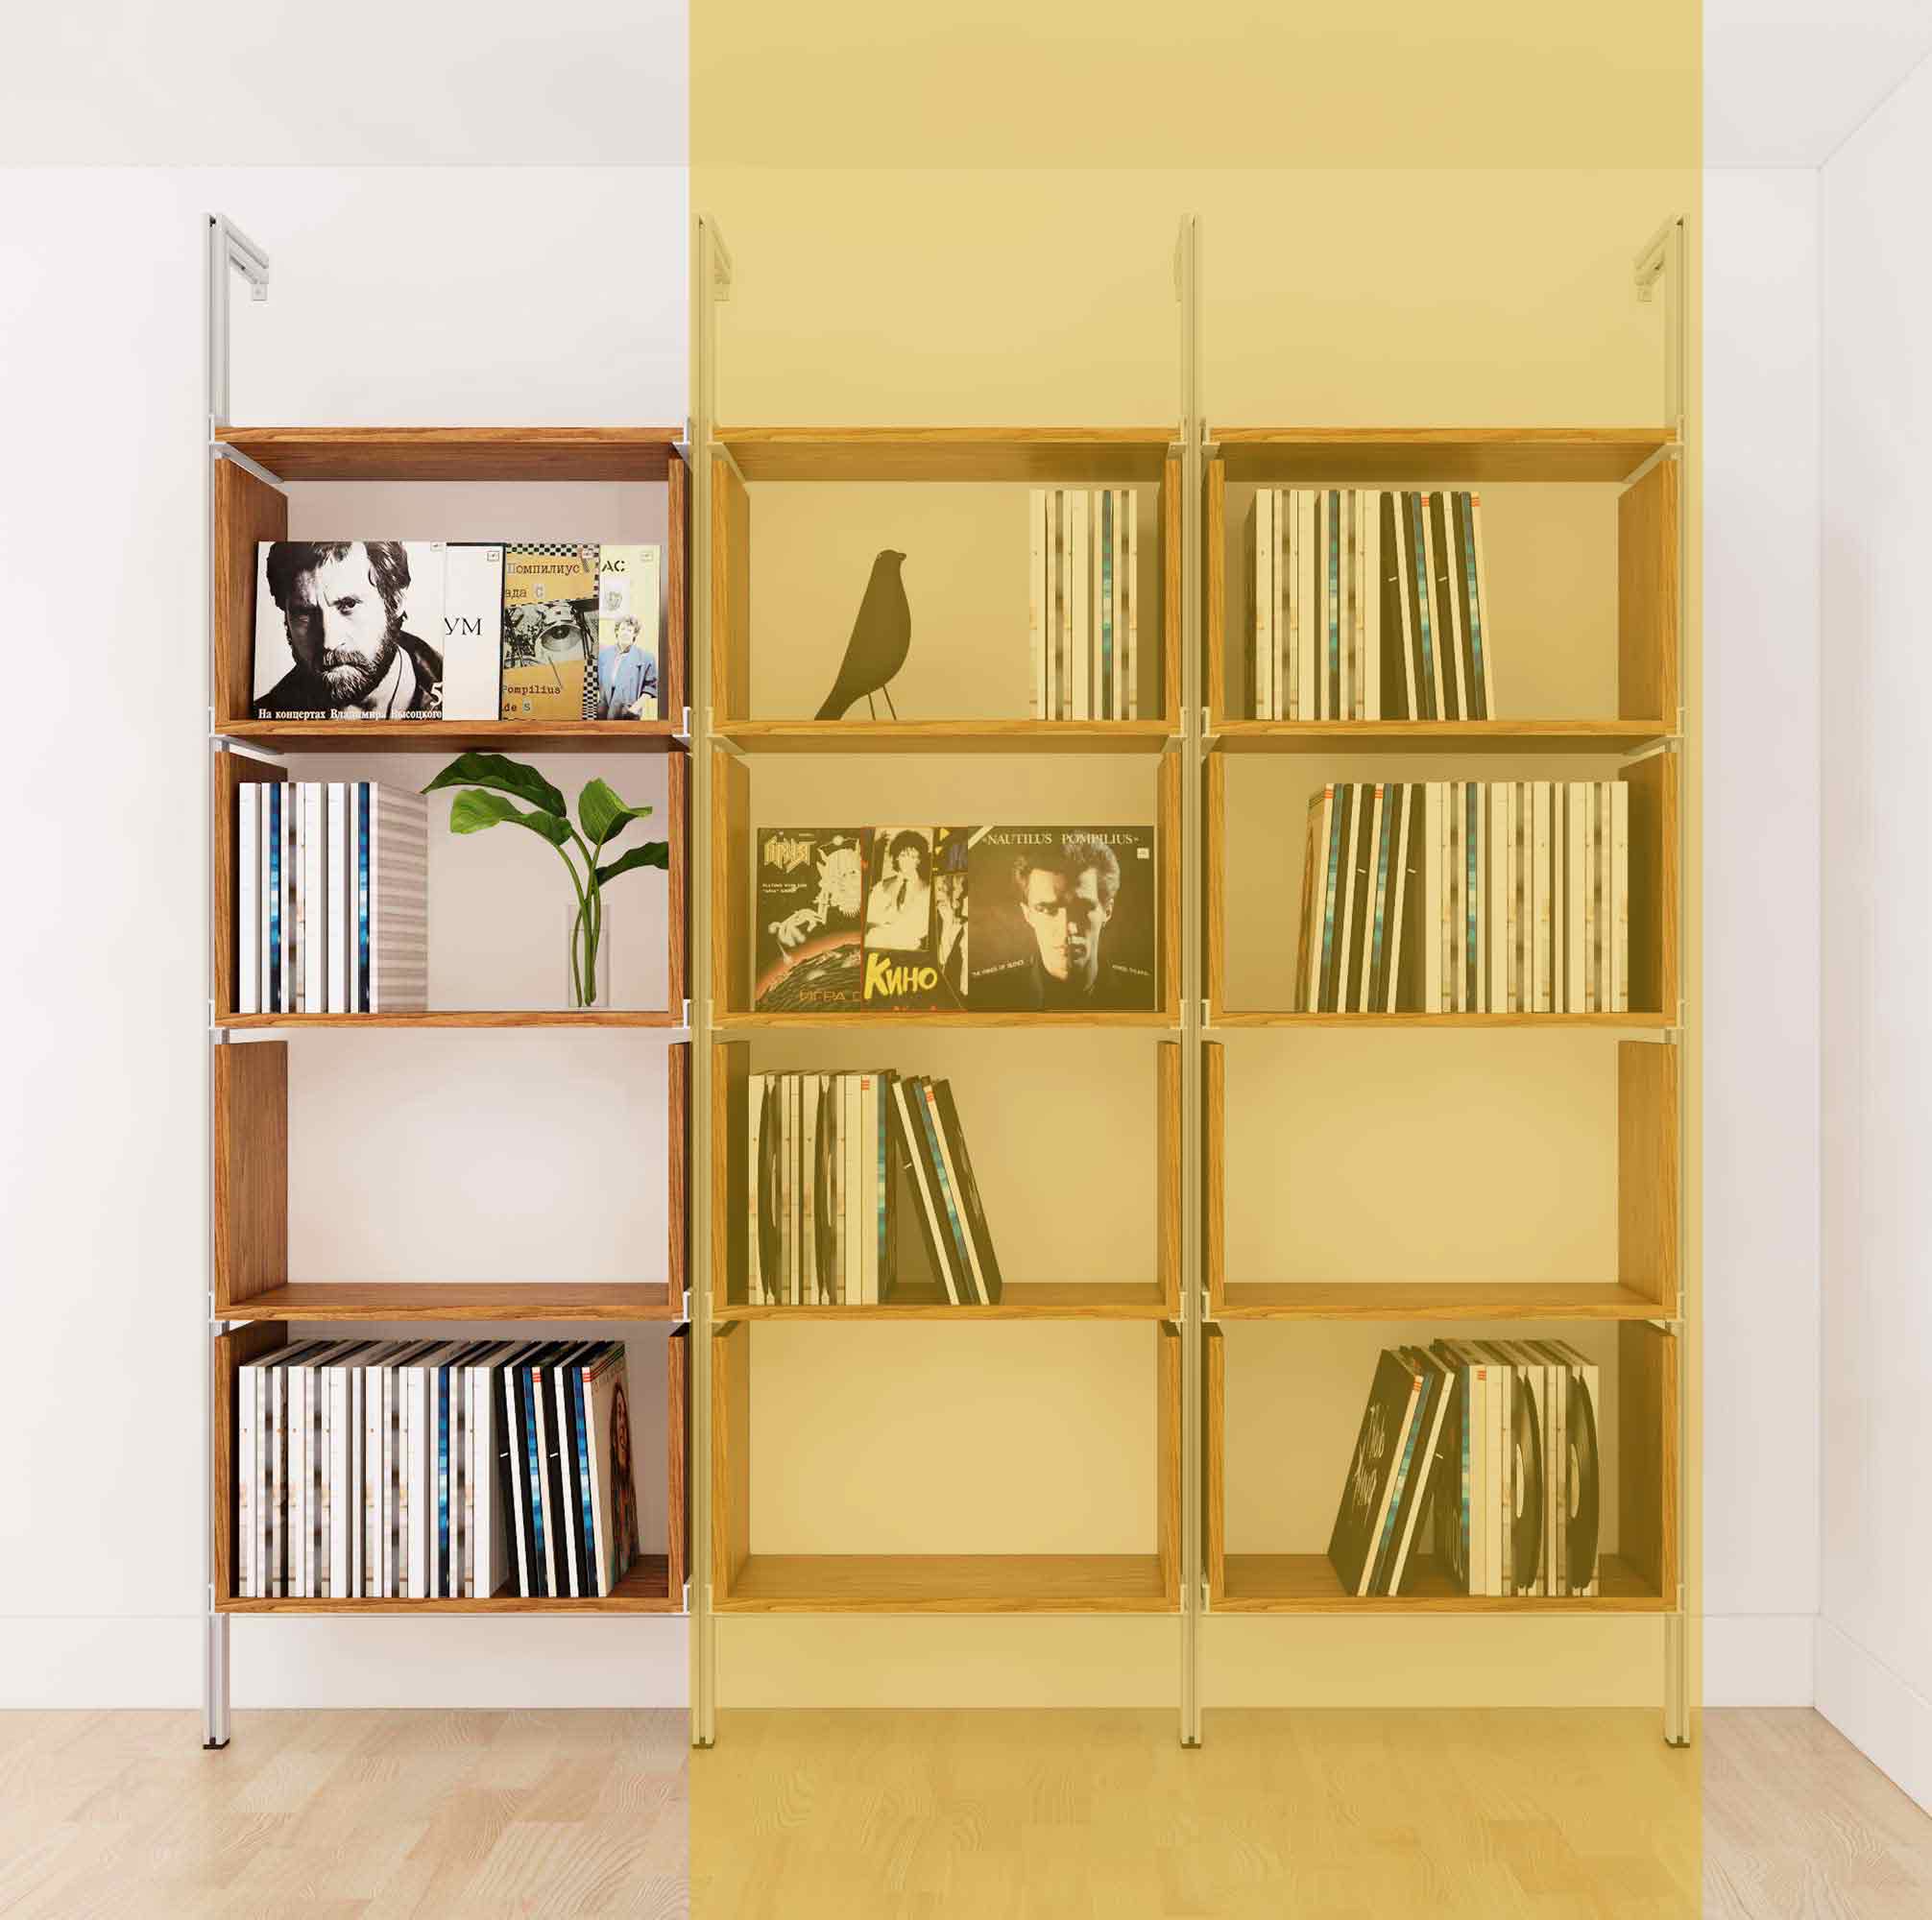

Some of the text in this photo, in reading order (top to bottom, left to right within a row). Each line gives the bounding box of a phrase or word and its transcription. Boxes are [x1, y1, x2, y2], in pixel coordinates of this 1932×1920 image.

[507, 562, 580, 576] Помпилиус
[444, 616, 482, 636] УМ
[429, 682, 443, 710] 5
[258, 708, 272, 719] На
[276, 710, 326, 721] концертах
[330, 708, 386, 720] Вламира
